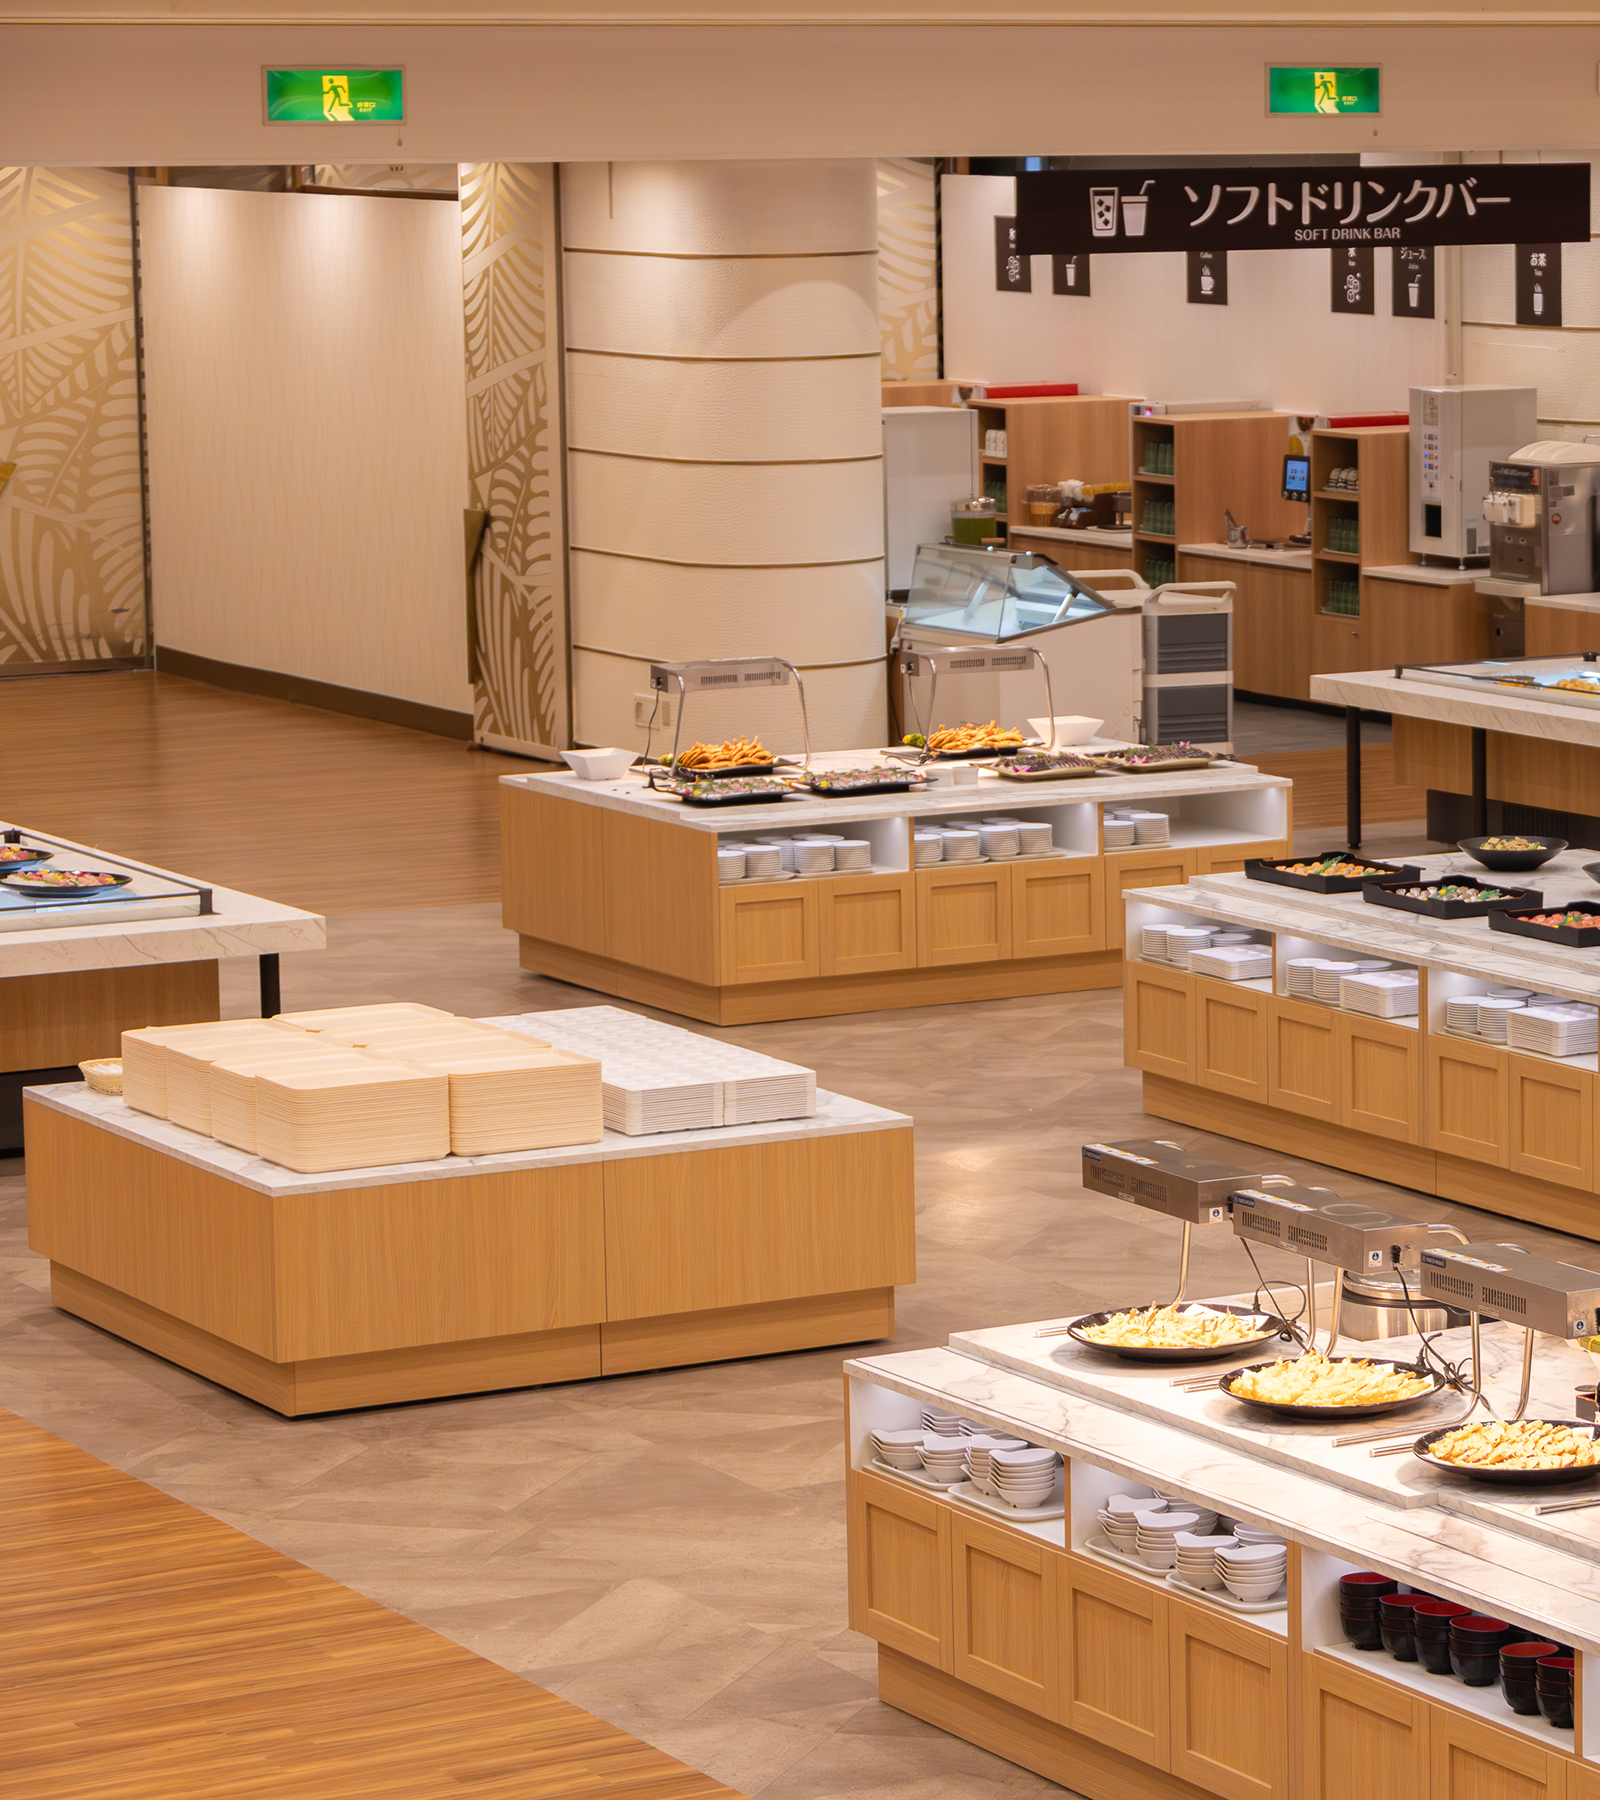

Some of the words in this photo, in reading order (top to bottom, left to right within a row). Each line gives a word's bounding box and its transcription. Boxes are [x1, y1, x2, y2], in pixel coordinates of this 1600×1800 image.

[1184, 177, 1511, 226] ソフトドリンクバー
[1294, 228, 1328, 240] SOFT
[1331, 228, 1371, 240] DRINK
[1374, 227, 1400, 239] BAR
[1400, 246, 1427, 260] ジュース
[1530, 252, 1547, 267] お茶
